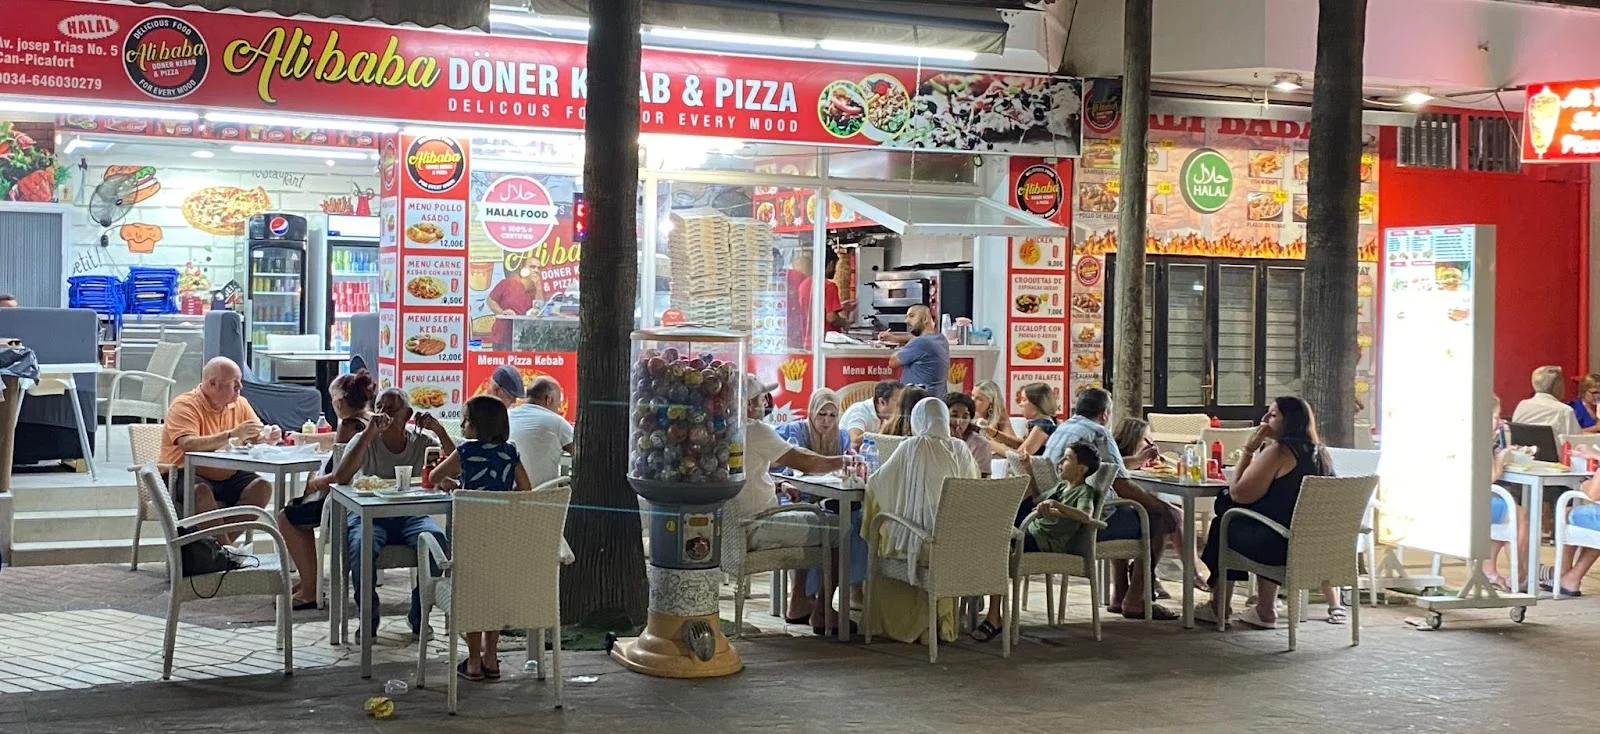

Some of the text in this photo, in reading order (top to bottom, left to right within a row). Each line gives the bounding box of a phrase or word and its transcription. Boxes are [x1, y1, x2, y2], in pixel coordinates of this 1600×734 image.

[66, 19, 113, 34] HALAL
[133, 19, 192, 40] DELICIOUS FOOD
[17, 37, 51, 54] josep
[53, 40, 84, 54] Trias
[87, 43, 107, 56] No.
[110, 44, 119, 57] 5
[153, 68, 180, 78] & PIZZA
[448, 50, 798, 113] DÖNER KAB & PIZZA
[138, 79, 197, 96] FOR EVERY MOOD
[448, 97, 798, 133] DELICOUS FO OR EVERY MOOD
[1193, 162, 1229, 184] حلال
[499, 183, 537, 202] حلال
[1194, 184, 1229, 197] HALAL
[408, 202, 463, 212] MENU POLLO
[421, 214, 450, 222] ASADO
[486, 207, 519, 217] HALAL
[520, 209, 549, 219] FOOD
[508, 225, 527, 233] 100%
[439, 239, 464, 248] 12,00€
[407, 260, 461, 269] MENU CARNE
[1358, 267, 1371, 275] AY
[1014, 276, 1063, 285] CROQUETAS DE
[543, 281, 551, 292] &
[407, 315, 461, 323] MENU SEEKH
[419, 325, 449, 334] KEBAB
[1014, 324, 1047, 332] ESCALOPE
[438, 353, 462, 361] 12,00€
[477, 354, 565, 366] Menu Pizza Kebab
[842, 365, 893, 376] Menu Kebab
[405, 374, 461, 383] MENU CALAMAR
[1013, 373, 1062, 381] PLATO FALAFEL
